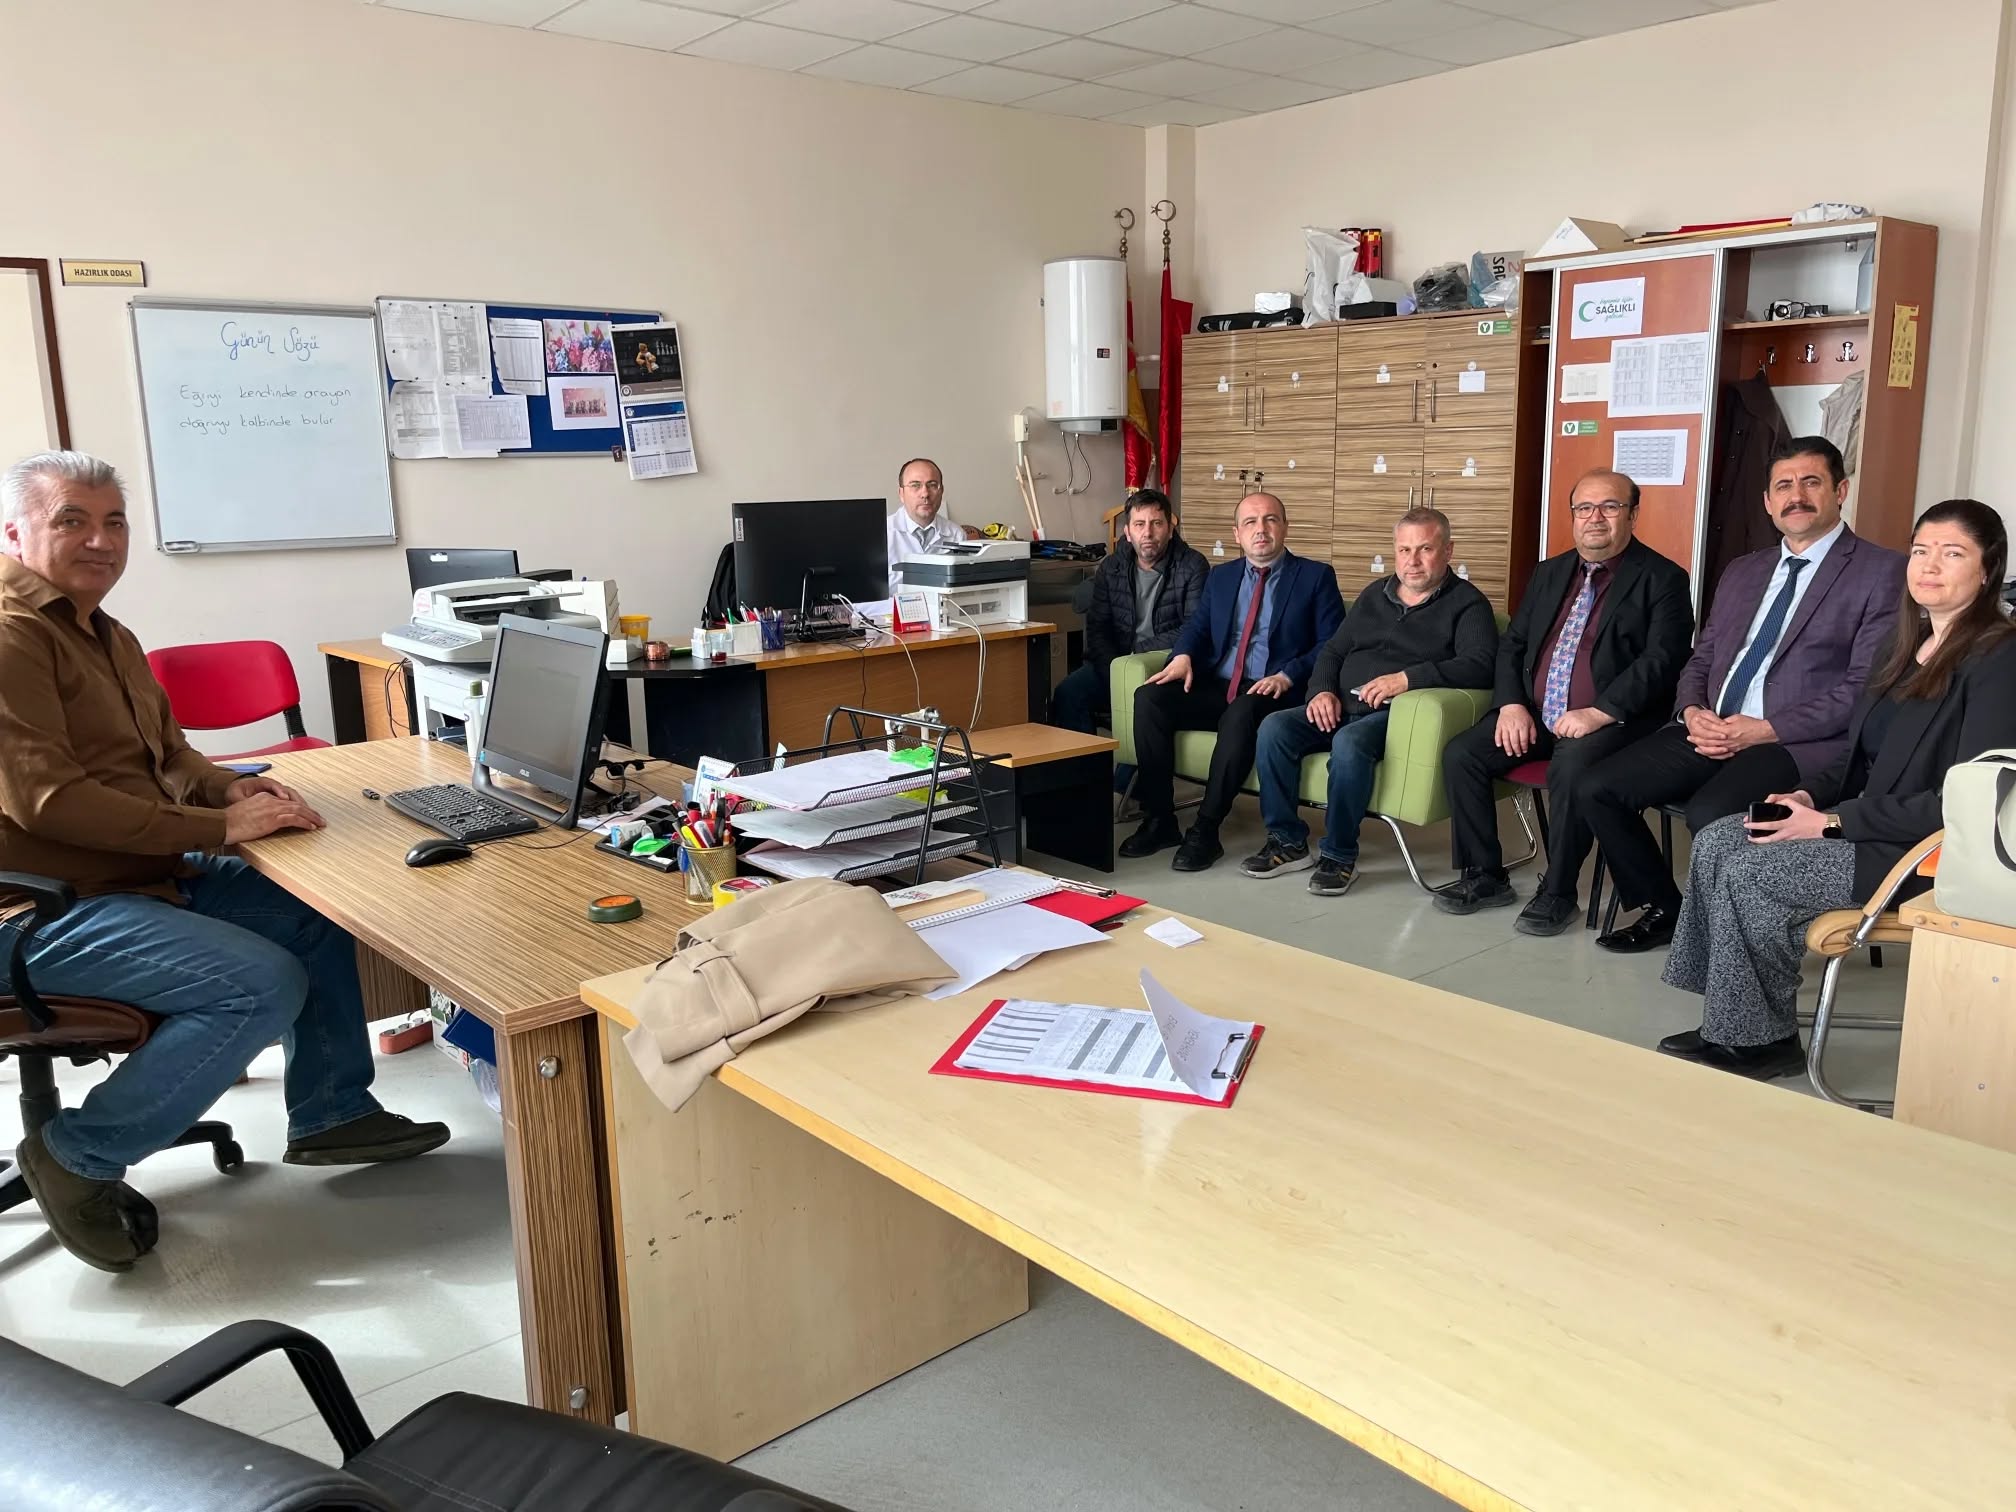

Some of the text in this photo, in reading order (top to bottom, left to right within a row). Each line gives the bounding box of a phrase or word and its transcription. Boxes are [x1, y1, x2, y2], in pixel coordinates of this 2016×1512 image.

[74, 268, 132, 277] HAZIRLIK ODASI
[1595, 303, 1636, 315] SAĞLIKLI
[221, 321, 320, 362] Günün Sözü
[239, 383, 298, 398] kendinde
[304, 389, 351, 407] arayan
[179, 413, 333, 435] doğruyu kalbinde bulur
